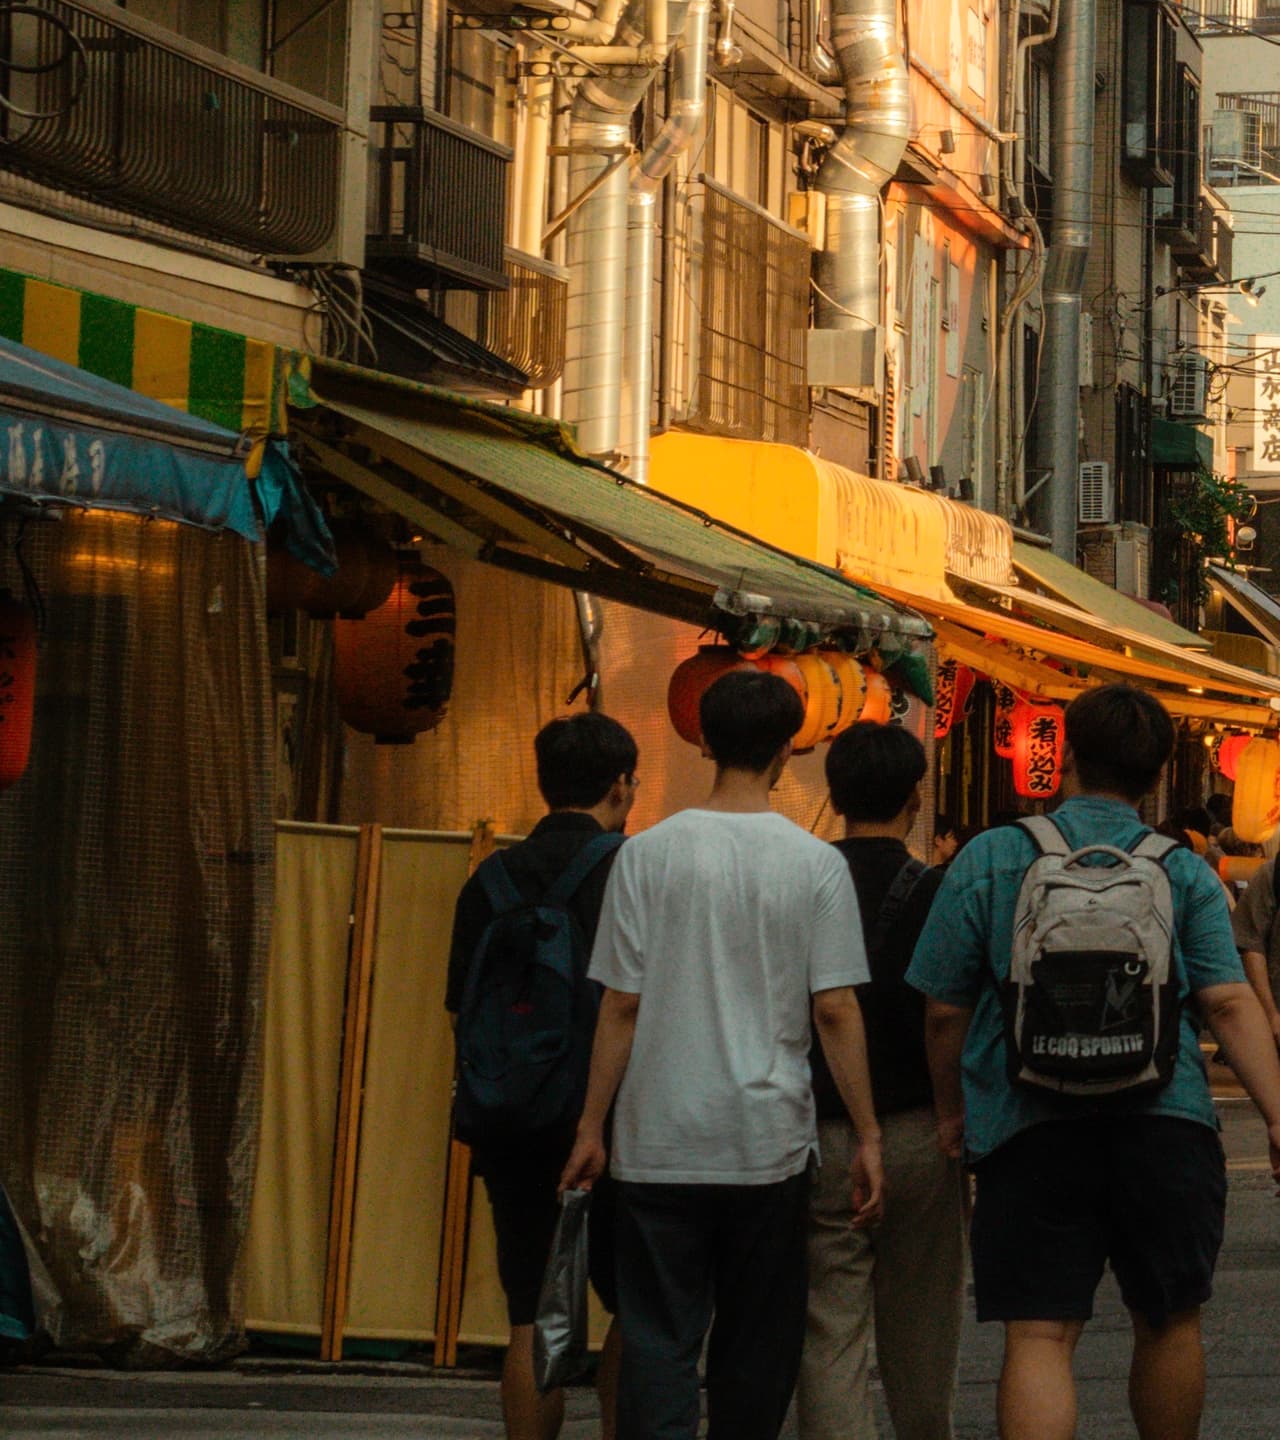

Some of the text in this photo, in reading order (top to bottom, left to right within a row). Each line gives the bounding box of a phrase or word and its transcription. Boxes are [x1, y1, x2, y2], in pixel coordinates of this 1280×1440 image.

[1028, 718, 1057, 791] 煮込み
[1032, 1033, 1143, 1058] LE COQ SPORTIF
